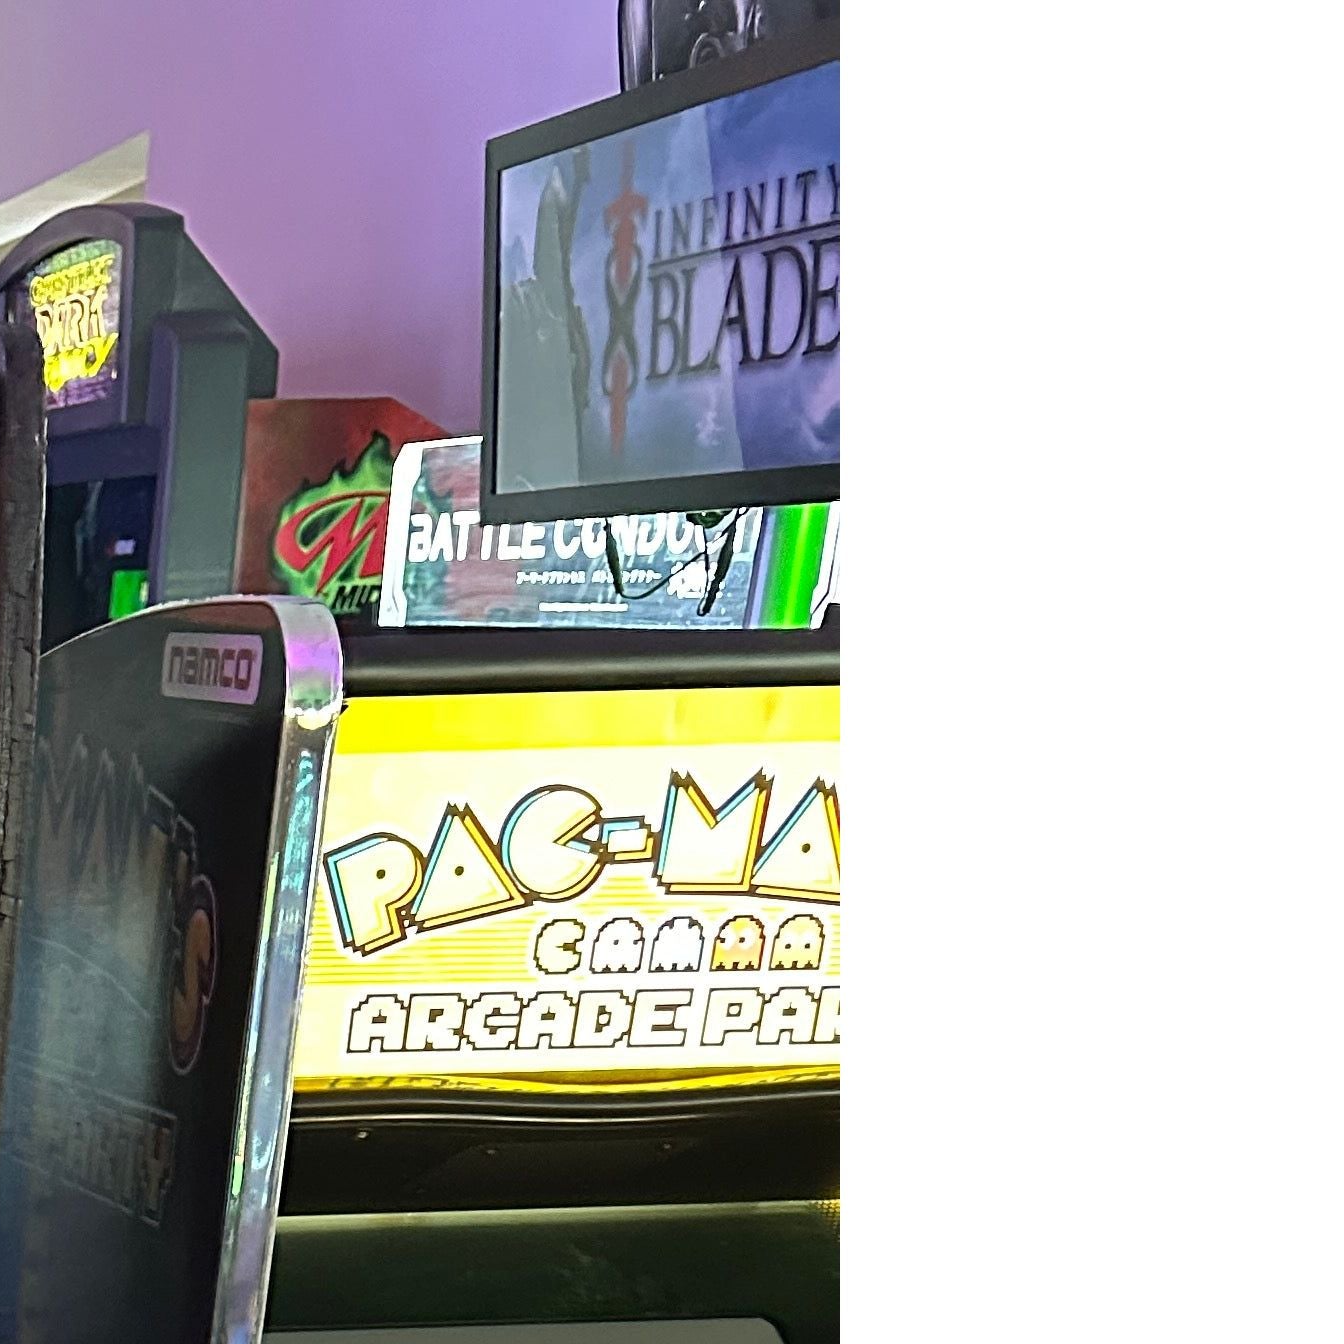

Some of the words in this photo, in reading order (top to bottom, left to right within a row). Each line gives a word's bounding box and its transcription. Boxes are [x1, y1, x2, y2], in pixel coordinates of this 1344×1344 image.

[653, 163, 840, 260] INFINITY
[647, 236, 840, 381] BLADE
[168, 645, 253, 691] namco
[346, 987, 694, 1054] ARCADE
